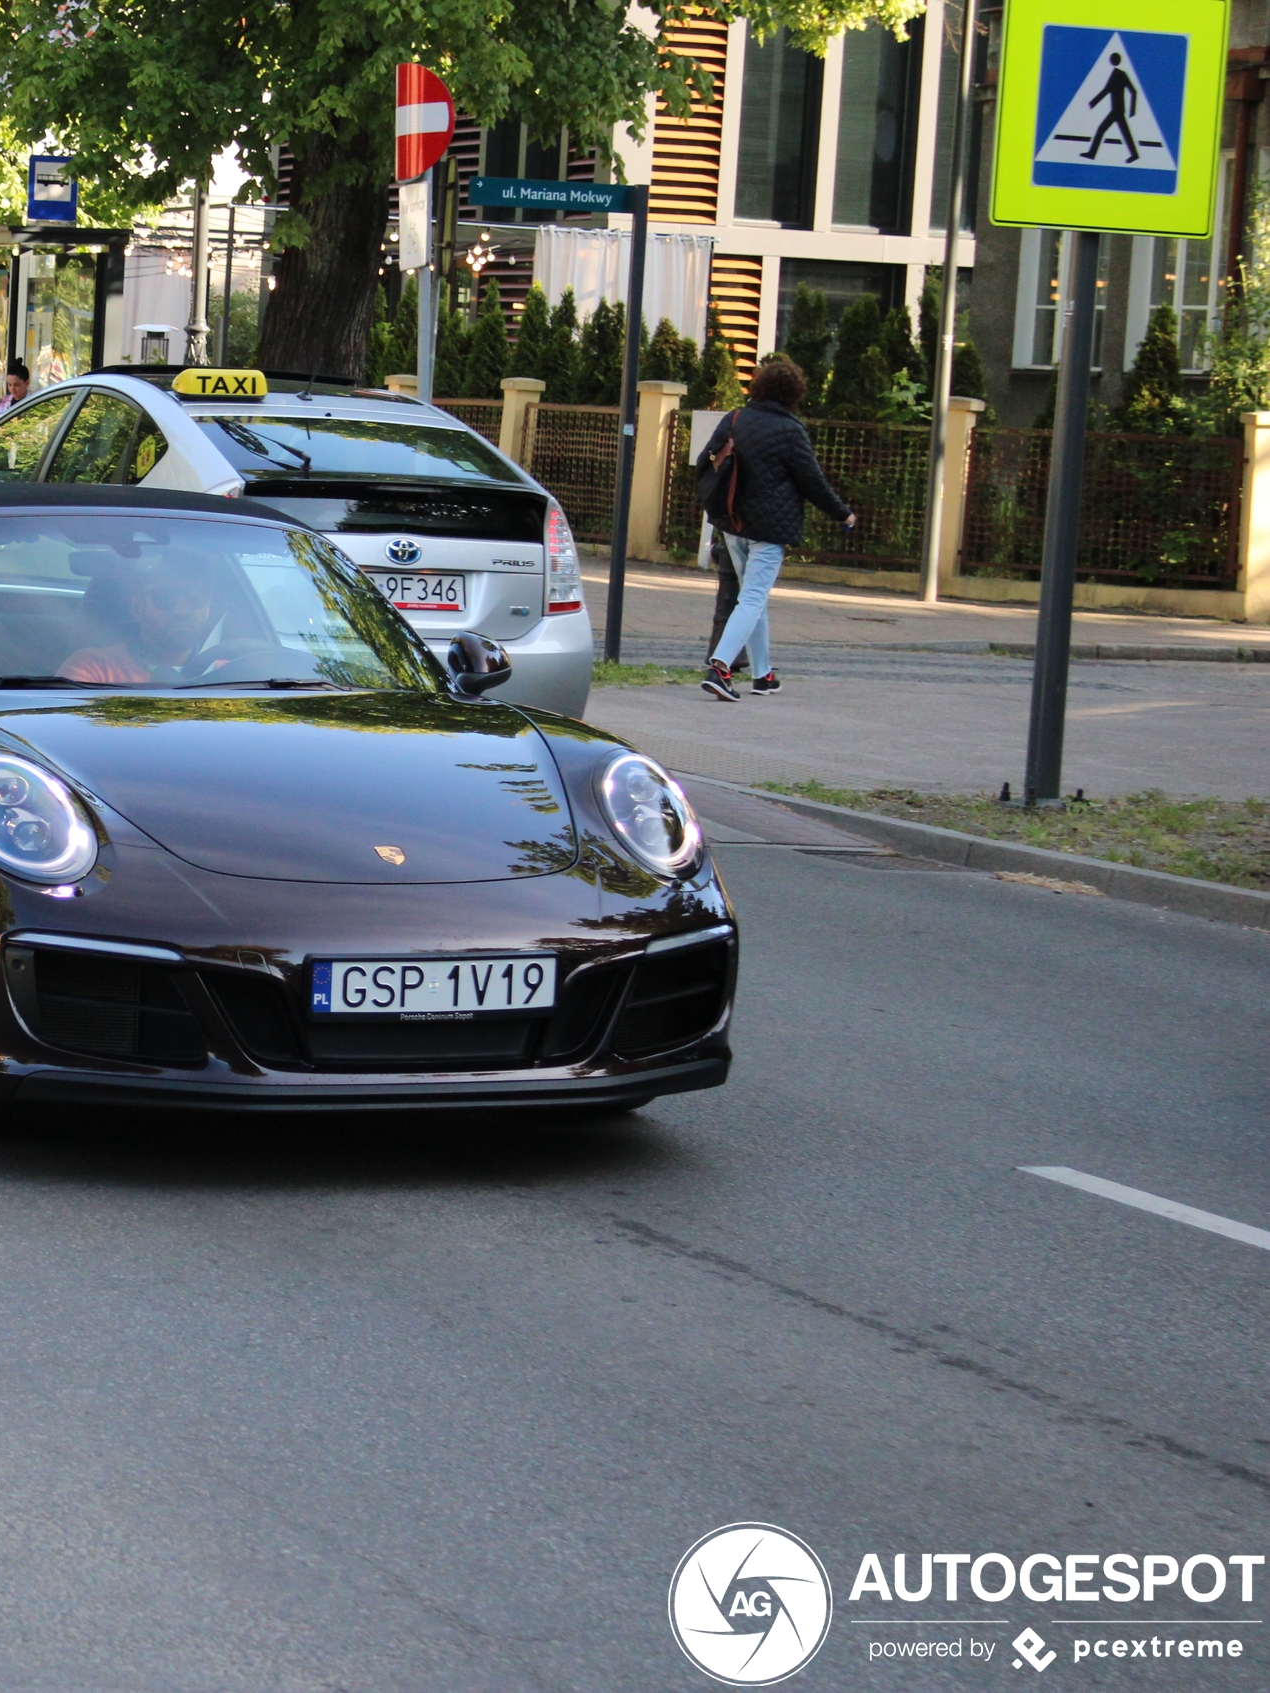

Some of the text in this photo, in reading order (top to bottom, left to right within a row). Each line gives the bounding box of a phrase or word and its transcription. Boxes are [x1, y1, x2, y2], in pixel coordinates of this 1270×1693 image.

[502, 186, 613, 207] ul. Mariana Mokwy
[196, 376, 257, 395] TAXI
[491, 558, 535, 567] PRIUS
[386, 576, 458, 602] 9F346
[342, 962, 544, 1008] GSP 1V19
[313, 993, 329, 1006] PL
[400, 1013, 426, 1021] Porsche
[426, 1012, 454, 1021] Centrum
